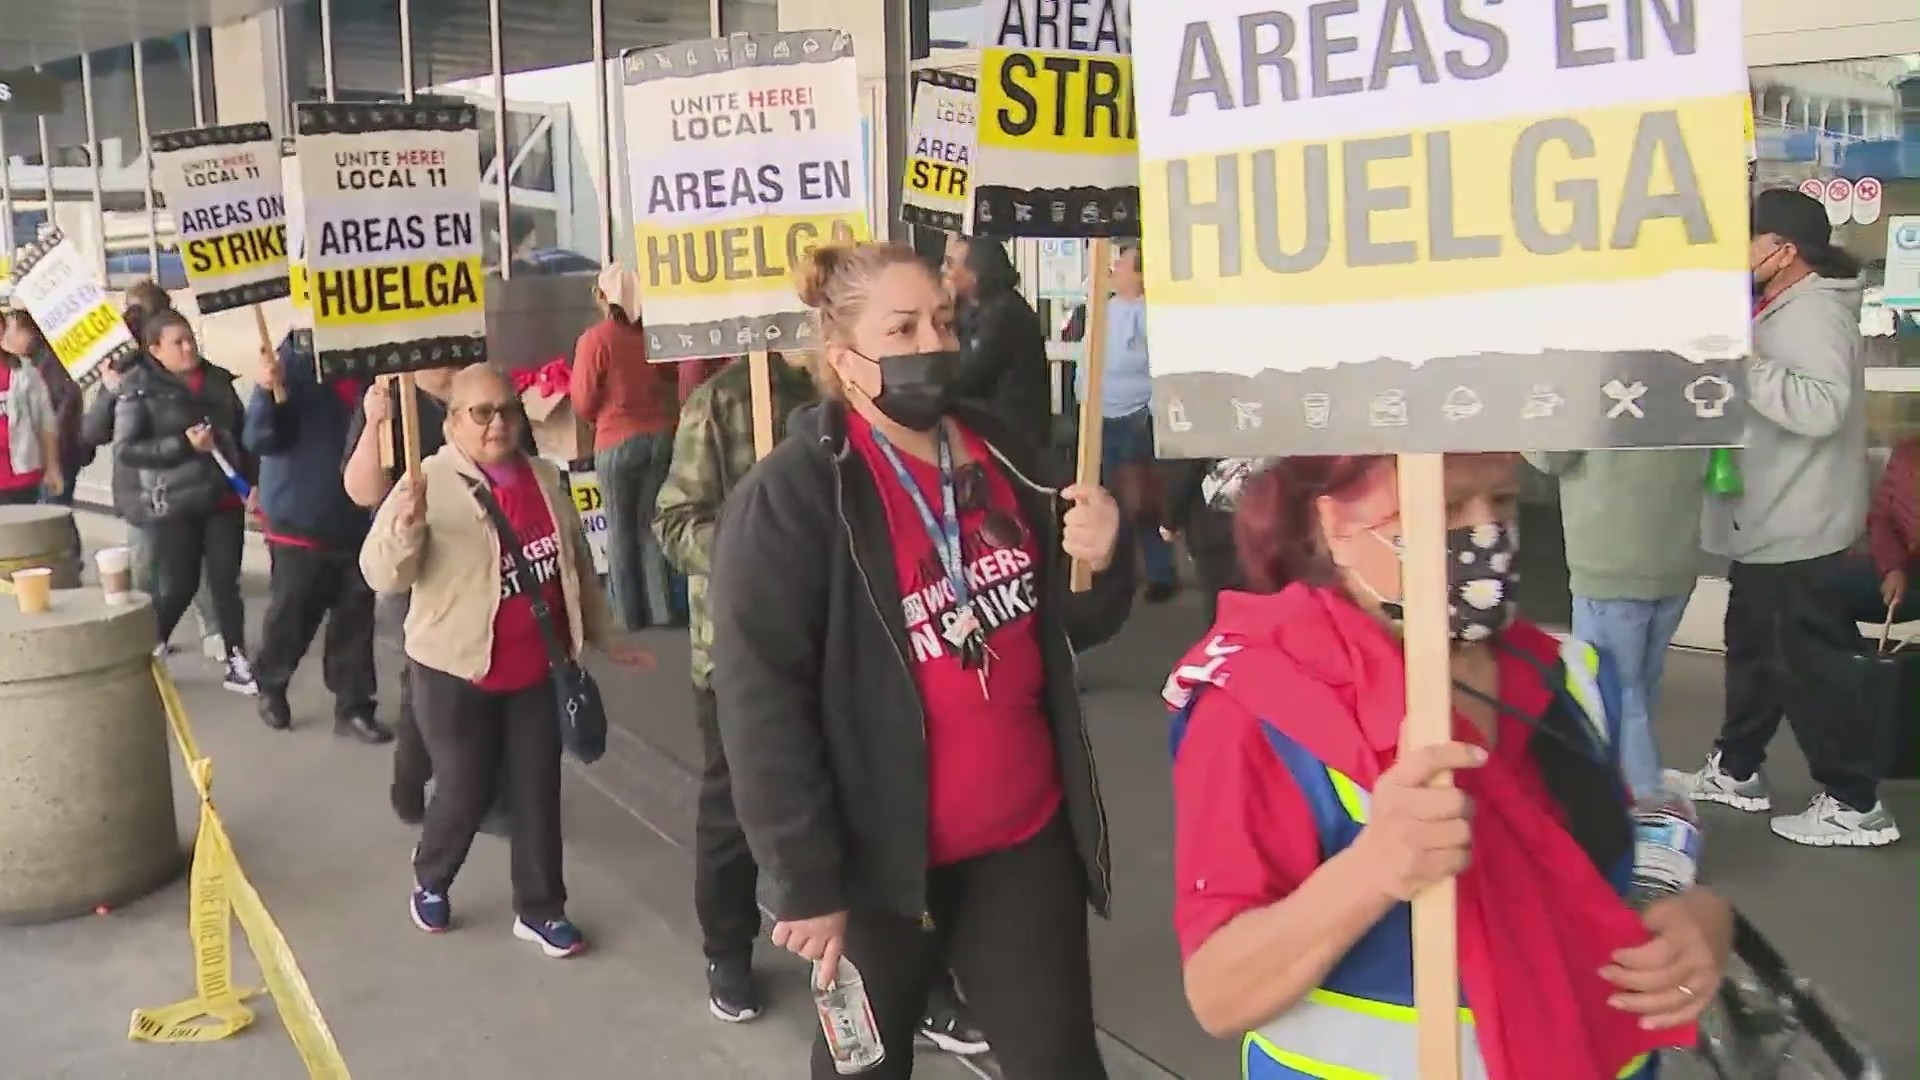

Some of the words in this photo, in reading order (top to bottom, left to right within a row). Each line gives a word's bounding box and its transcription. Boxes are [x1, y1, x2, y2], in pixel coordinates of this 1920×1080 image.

[997, 0, 1133, 53] AREA
[1170, 0, 1509, 116] AREAS
[1555, 0, 1697, 69] EN
[670, 92, 740, 116] UNITE
[748, 86, 813, 108] HERE!
[671, 112, 774, 142] LOCAL
[789, 108, 817, 131] 11
[184, 168, 240, 187] LOCAL
[245, 166, 261, 180] 11
[335, 150, 391, 167] UNITE
[396, 150, 446, 166] HERE!
[336, 168, 417, 190] LOCAL
[426, 168, 448, 188] 11
[648, 164, 784, 214] AREAS
[798, 160, 851, 200] EN
[1166, 110, 1717, 281] HUELGA
[182, 200, 253, 234] AREAS
[257, 195, 286, 220] ON
[319, 214, 426, 256] AREAS
[434, 213, 473, 247] EN
[189, 223, 288, 272] STRIKE
[317, 261, 479, 317] HUELGA
[922, 548, 1032, 613] WOKERS
